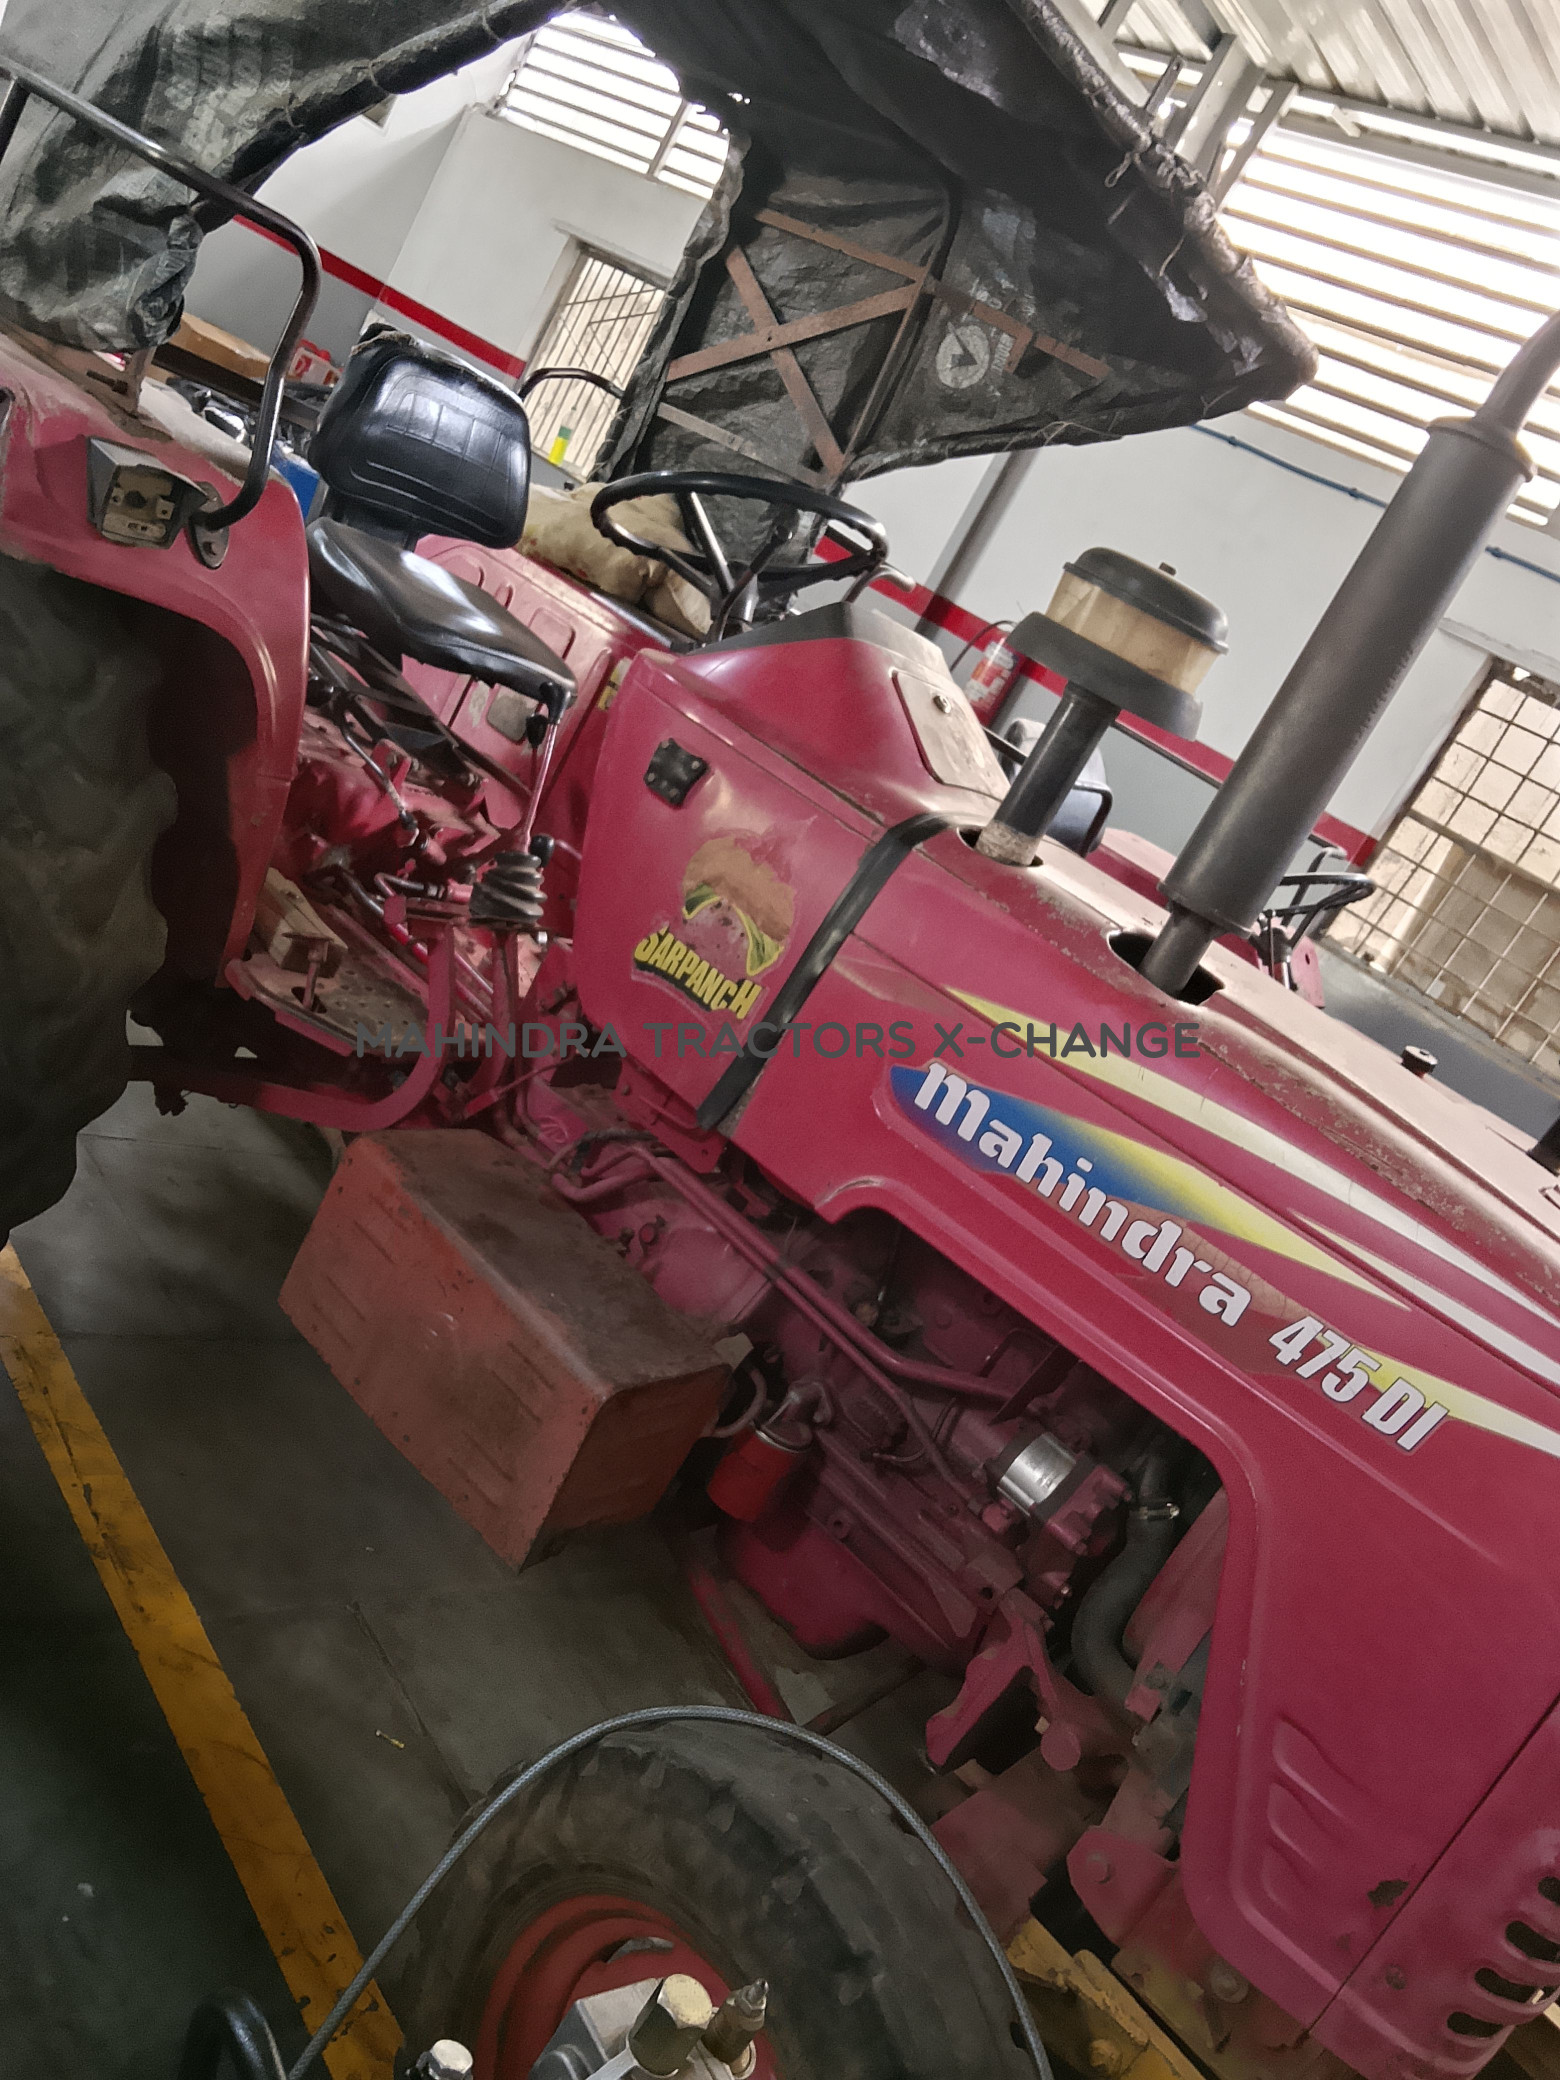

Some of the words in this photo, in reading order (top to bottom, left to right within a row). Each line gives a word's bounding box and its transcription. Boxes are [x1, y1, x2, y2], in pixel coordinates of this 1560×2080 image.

[634, 921, 762, 1020] SARPANCH
[1268, 1316, 1381, 1403] 475
[1361, 1376, 1450, 1451] DI
